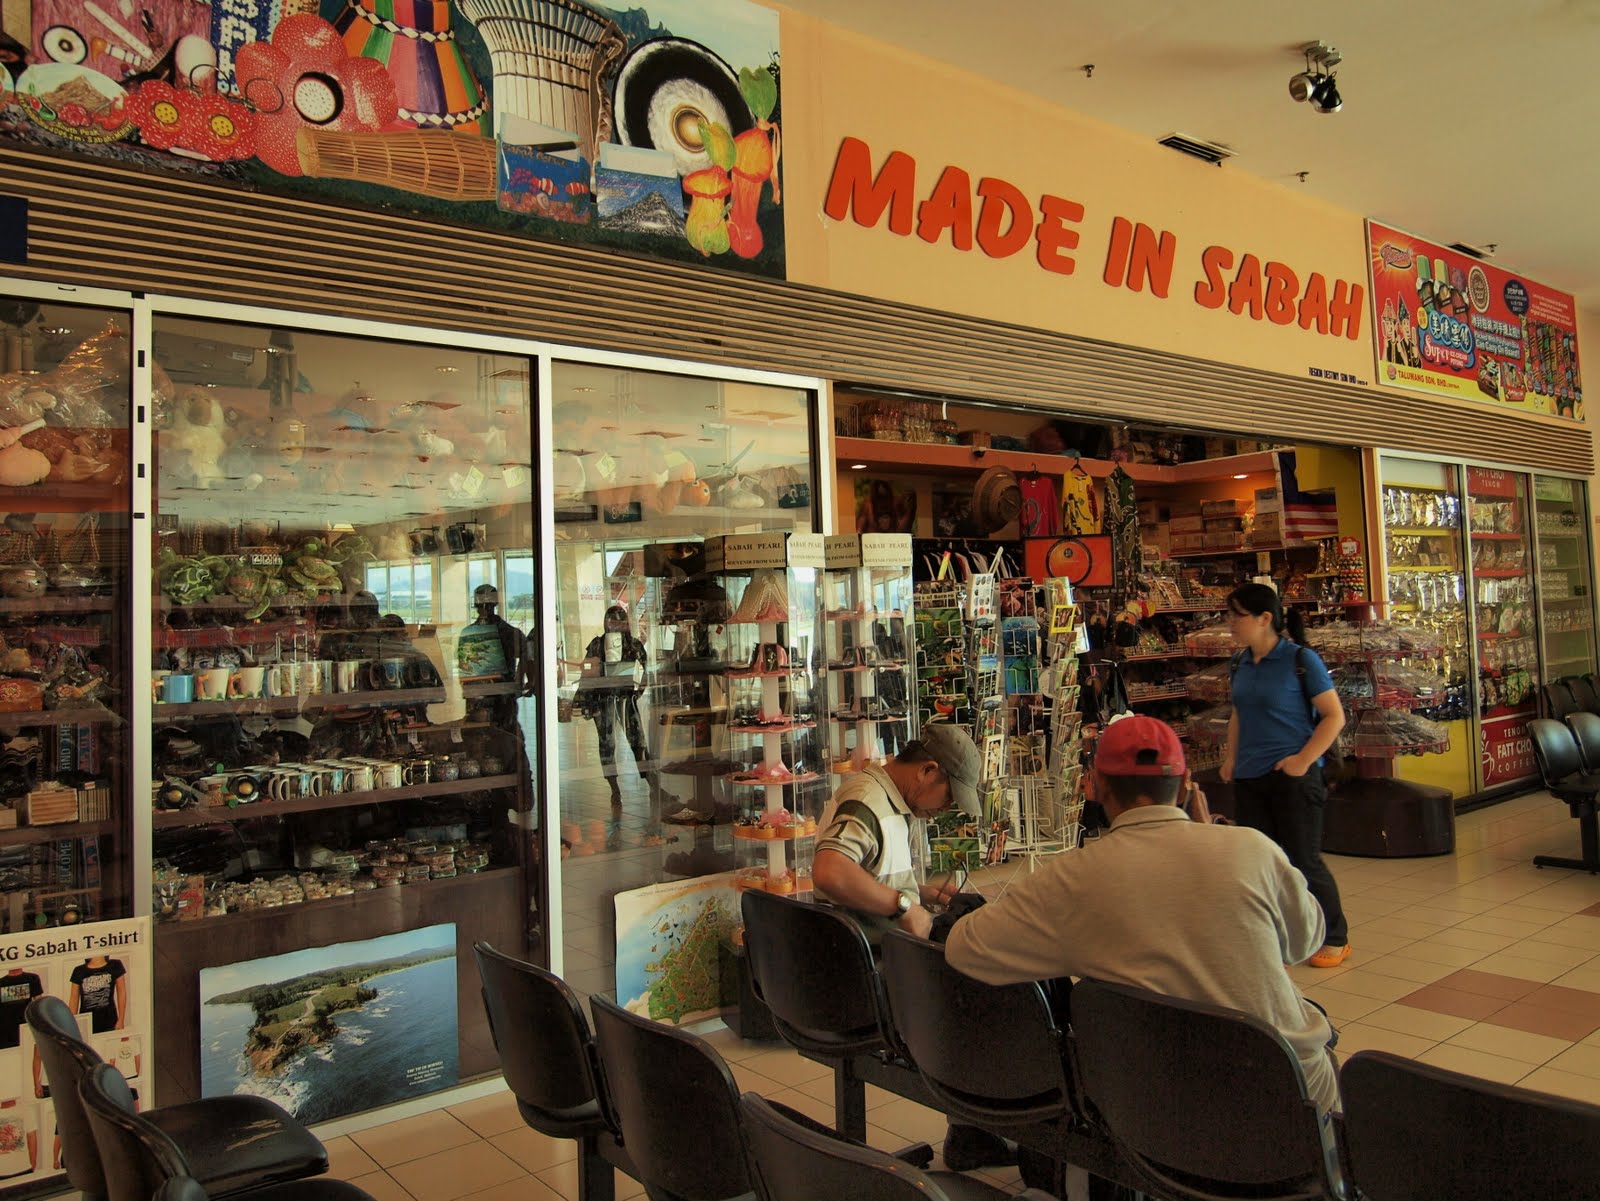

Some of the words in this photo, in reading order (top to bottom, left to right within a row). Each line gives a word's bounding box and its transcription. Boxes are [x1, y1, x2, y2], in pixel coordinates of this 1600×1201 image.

[825, 137, 1085, 276] MADE
[1103, 216, 1177, 299] IN
[1194, 245, 1364, 341] SABAH
[1424, 334, 1448, 362] Super
[1497, 742, 1514, 759] FATT
[1498, 756, 1535, 774] COFFEE
[25, 938, 78, 958] Sabah
[83, 930, 139, 950] T-shirt
